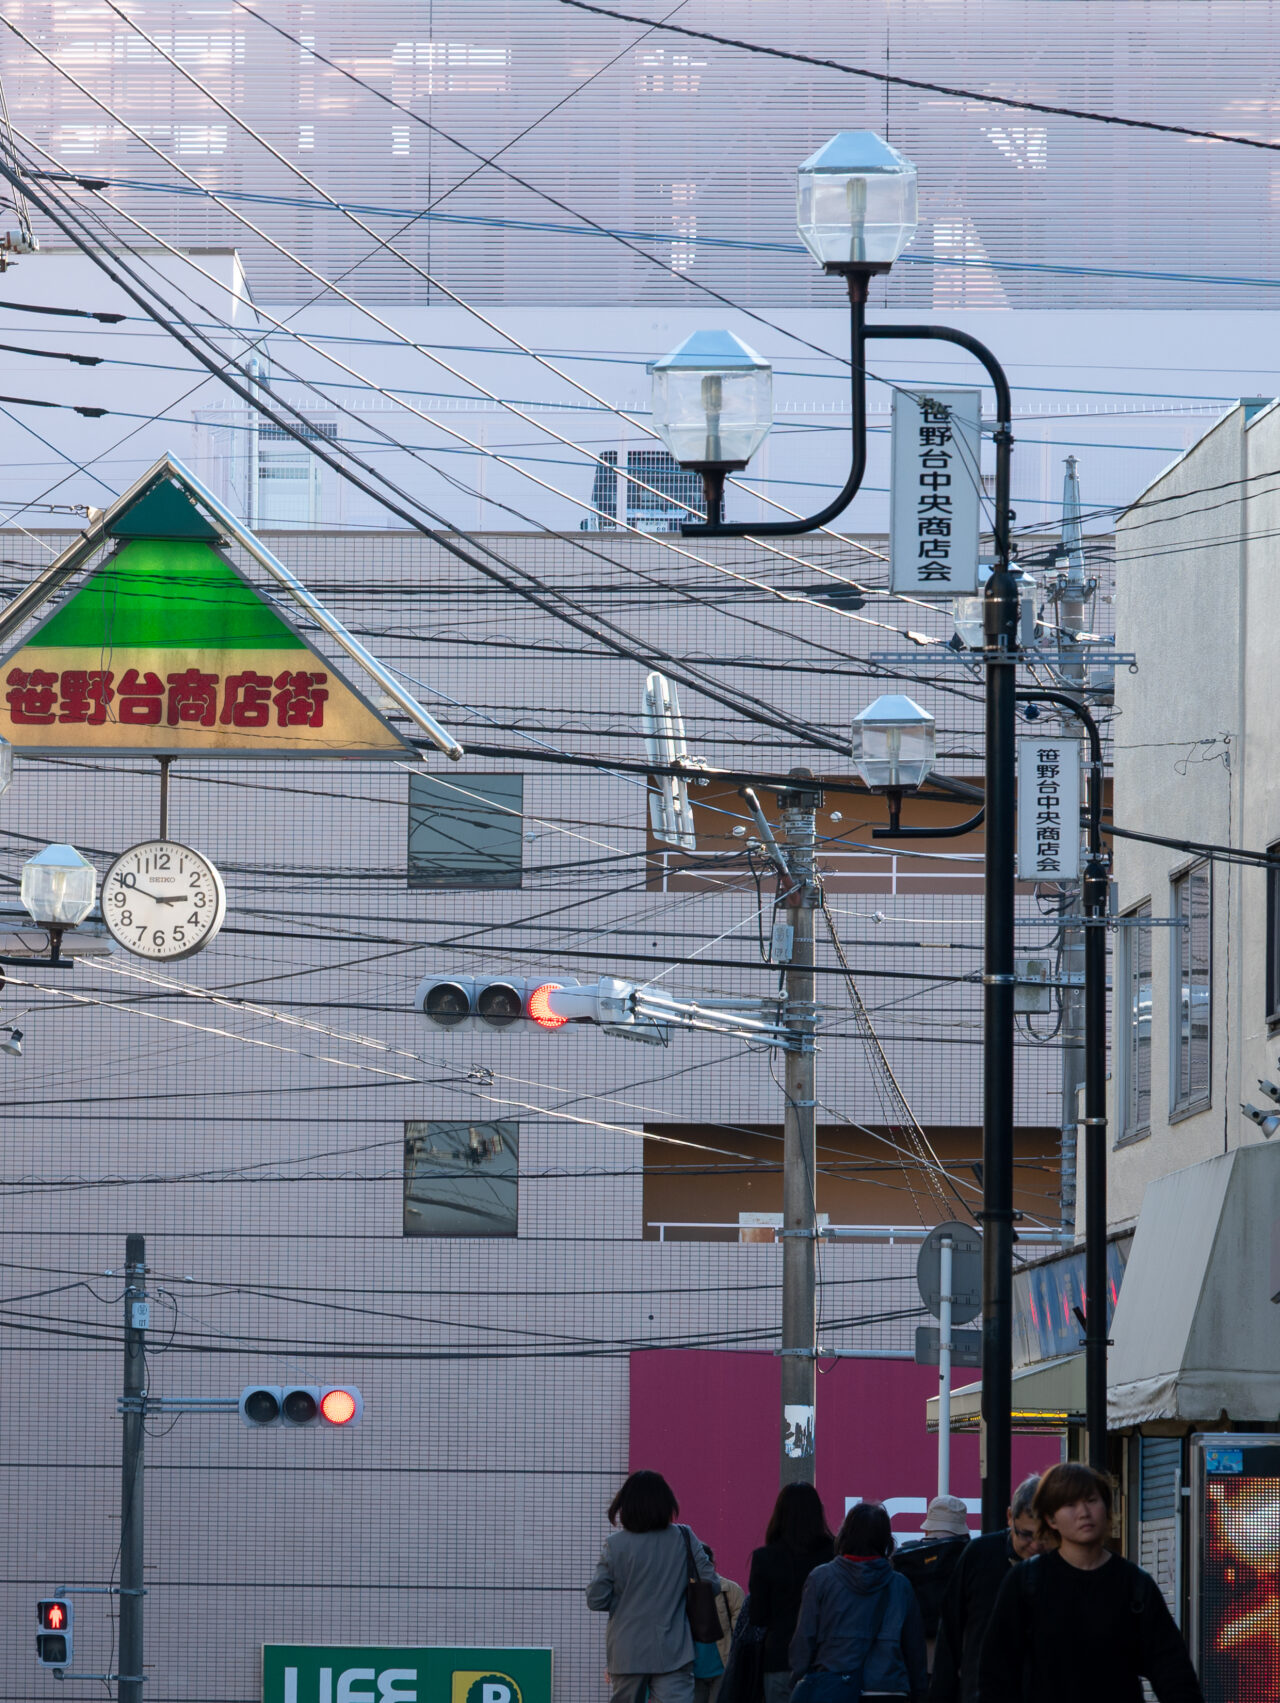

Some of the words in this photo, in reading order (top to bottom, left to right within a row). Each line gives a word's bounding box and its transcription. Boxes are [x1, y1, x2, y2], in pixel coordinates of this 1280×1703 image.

[917, 399, 953, 582] 笹野台中央商店会
[6, 667, 329, 727] 笹野台商店街
[1036, 748, 1061, 873] 笹野台中央商店会
[137, 858, 149, 874] 11
[154, 853, 171, 870] 12
[180, 858, 183, 874] 1
[120, 872, 136, 889] 10
[189, 871, 201, 888] 2
[114, 892, 126, 908] 9
[194, 892, 206, 908] 3
[120, 910, 132, 926] 8
[187, 911, 200, 927] 4
[135, 926, 148, 941] 7
[153, 930, 165, 947] 6
[172, 926, 185, 942] 5
